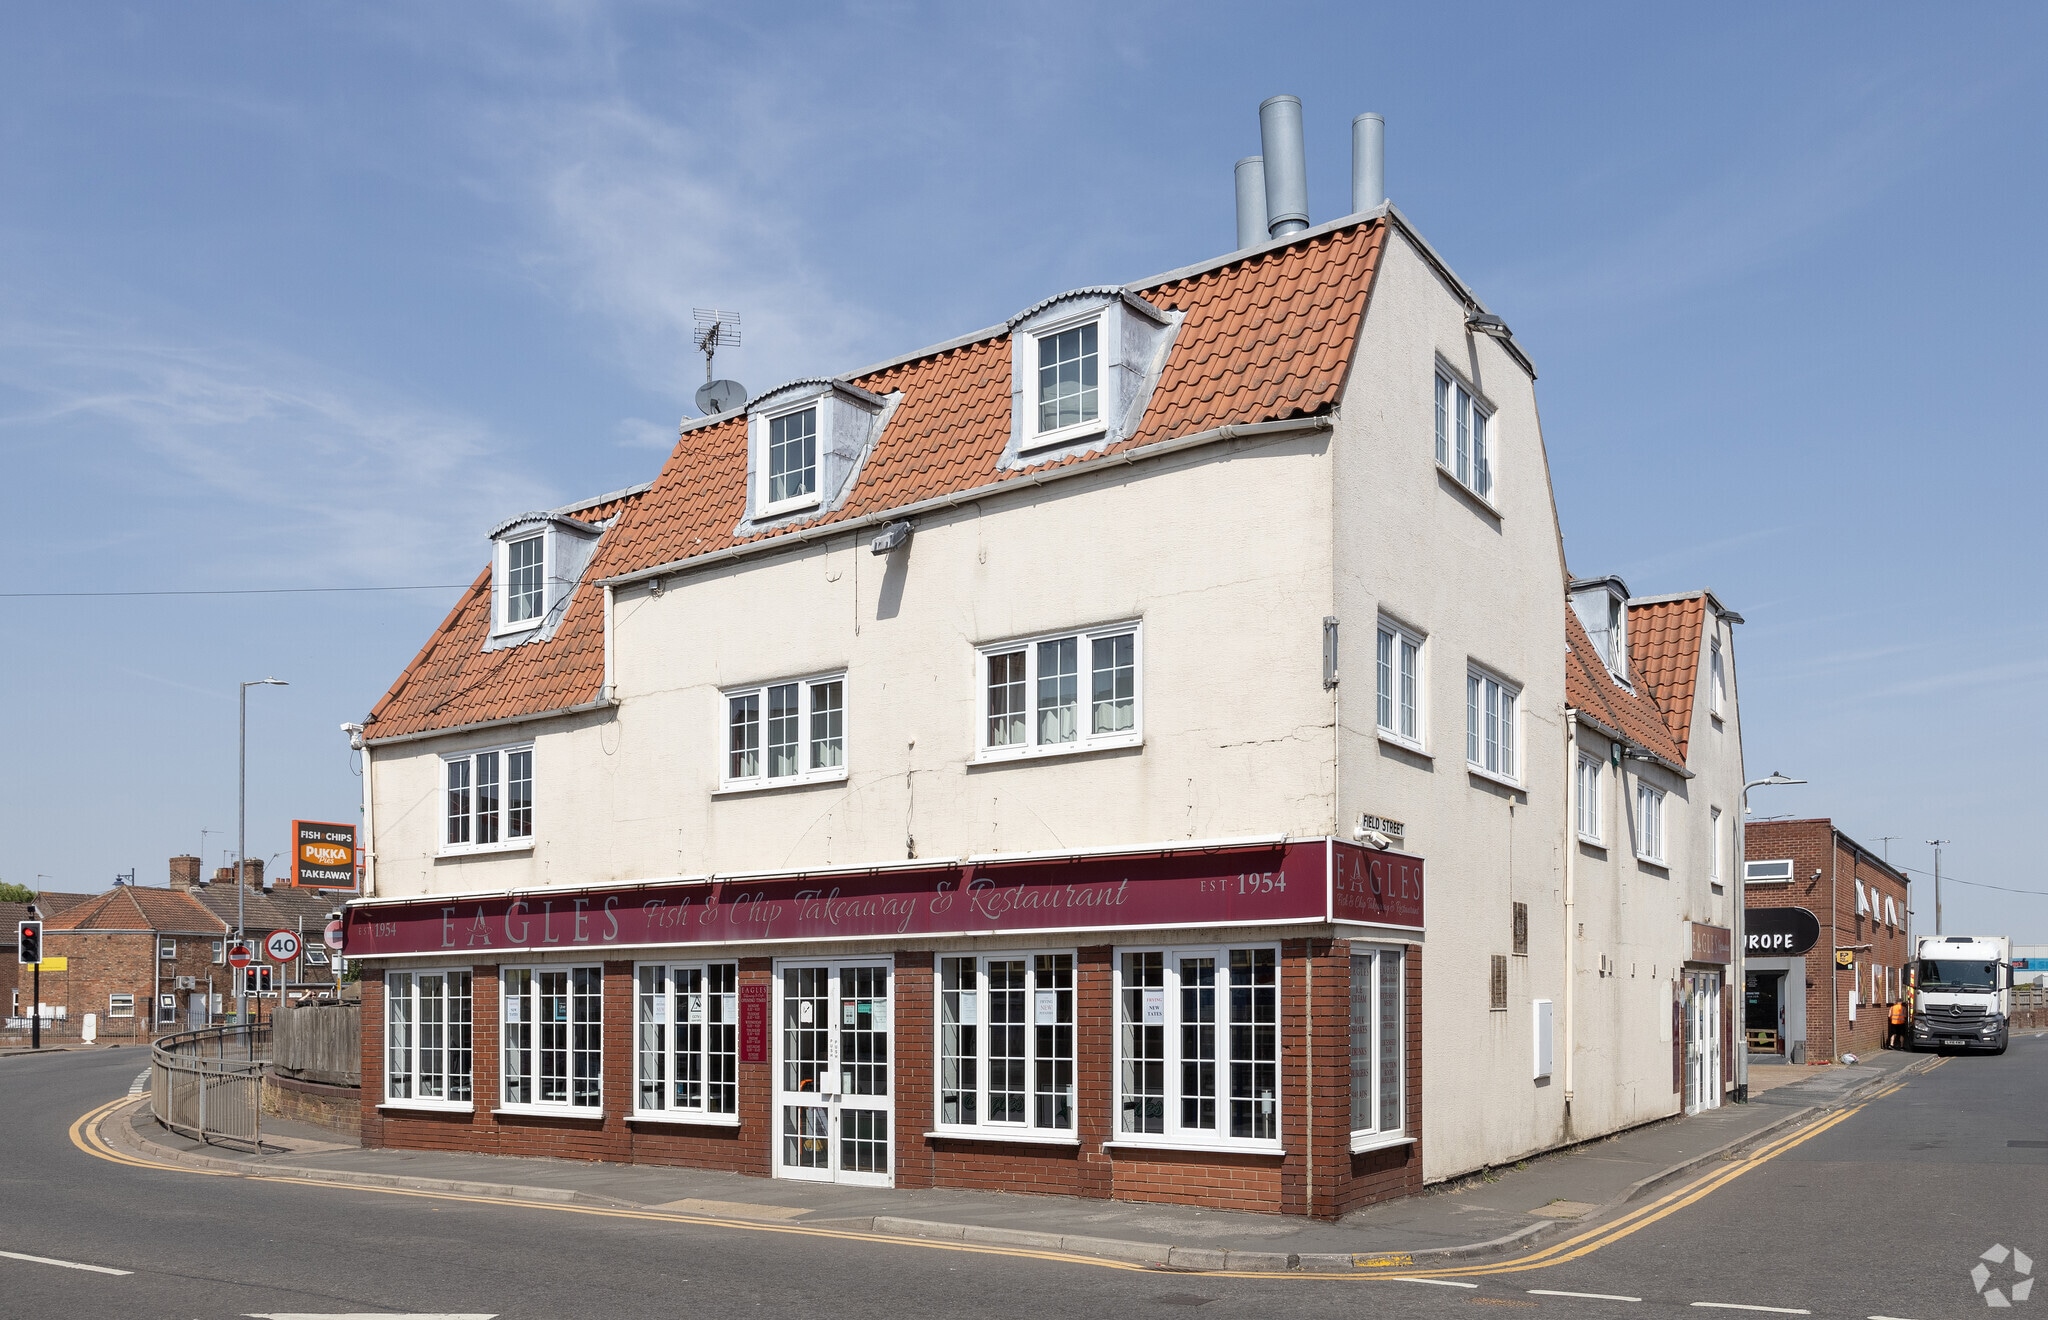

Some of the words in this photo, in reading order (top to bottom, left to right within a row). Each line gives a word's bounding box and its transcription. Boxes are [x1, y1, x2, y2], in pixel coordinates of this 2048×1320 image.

[1363, 814, 1380, 830] FIELD
[1382, 819, 1404, 836] STREET
[300, 830, 321, 840] FISH
[325, 832, 352, 842] CHIPS
[305, 845, 347, 860] PUKKA
[300, 869, 352, 880] TAKEAWAY
[1336, 853, 1420, 900] EAGLES
[441, 895, 620, 948] EAGLES
[642, 896, 691, 929] Fish
[699, 896, 719, 926] &
[730, 891, 782, 938] Chip
[794, 886, 917, 934] Takeaway
[929, 881, 953, 915] &
[966, 877, 1129, 920] Restaurant
[1237, 870, 1287, 894] 1954
[374, 922, 397, 938] 1954
[270, 939, 296, 953] 40
[741, 986, 767, 994] EAGLES
